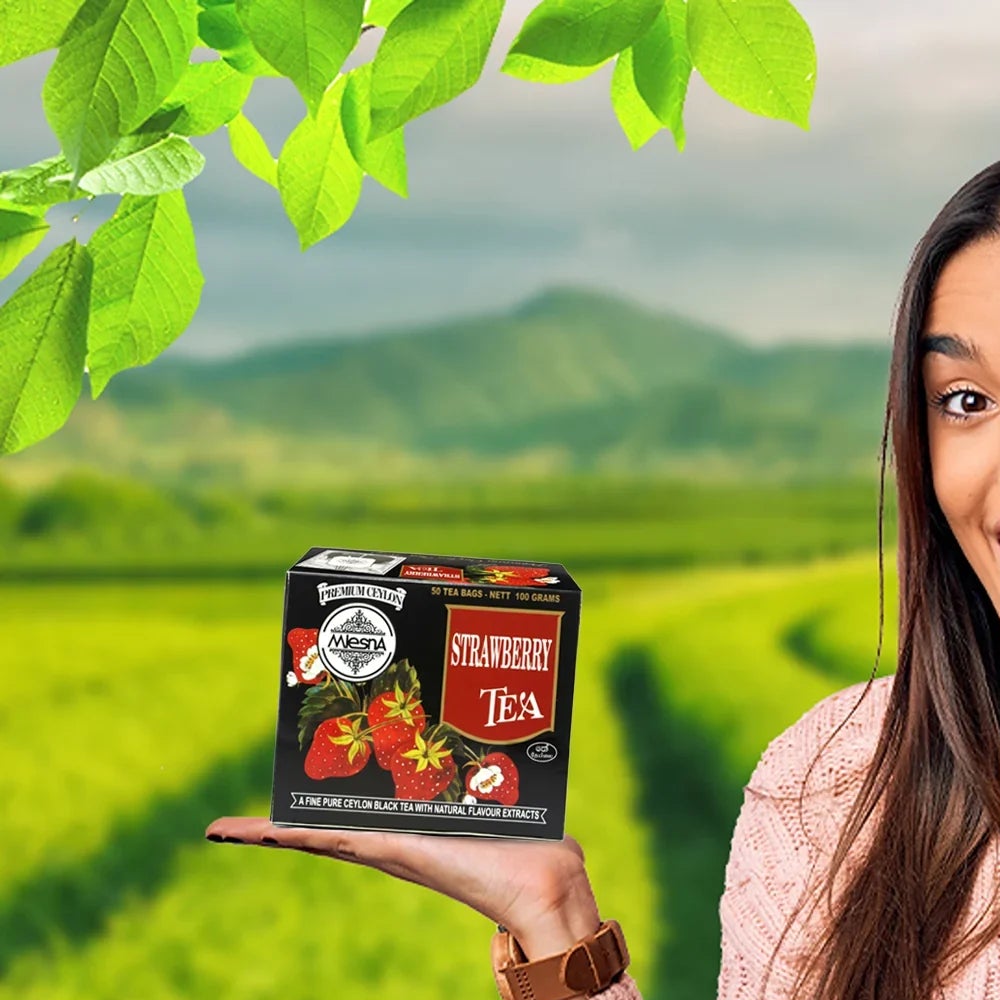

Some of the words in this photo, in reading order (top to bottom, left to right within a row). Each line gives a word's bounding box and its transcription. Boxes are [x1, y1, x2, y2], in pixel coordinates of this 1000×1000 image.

[321, 584, 366, 601] PREMIUM
[367, 585, 402, 606] CEYLON
[432, 587, 438, 595] 50
[440, 588, 458, 596] TEA
[461, 589, 483, 598] BAGS
[489, 590, 510, 600] NETT
[516, 592, 529, 601] 100
[531, 593, 560, 603] GRAMS
[451, 633, 552, 671] STRAWBERRY
[480, 687, 544, 727] TEA
[299, 796, 304, 806] A
[306, 796, 321, 807] FINE
[323, 797, 342, 808] PURE
[344, 798, 372, 810] CEYLON
[374, 800, 398, 811] BLACK
[400, 802, 414, 812] TEA
[415, 802, 433, 813] WITH
[435, 804, 466, 815] NATURAL
[468, 806, 500, 817] FLAVOUR
[503, 808, 539, 820] EXTRACTS
